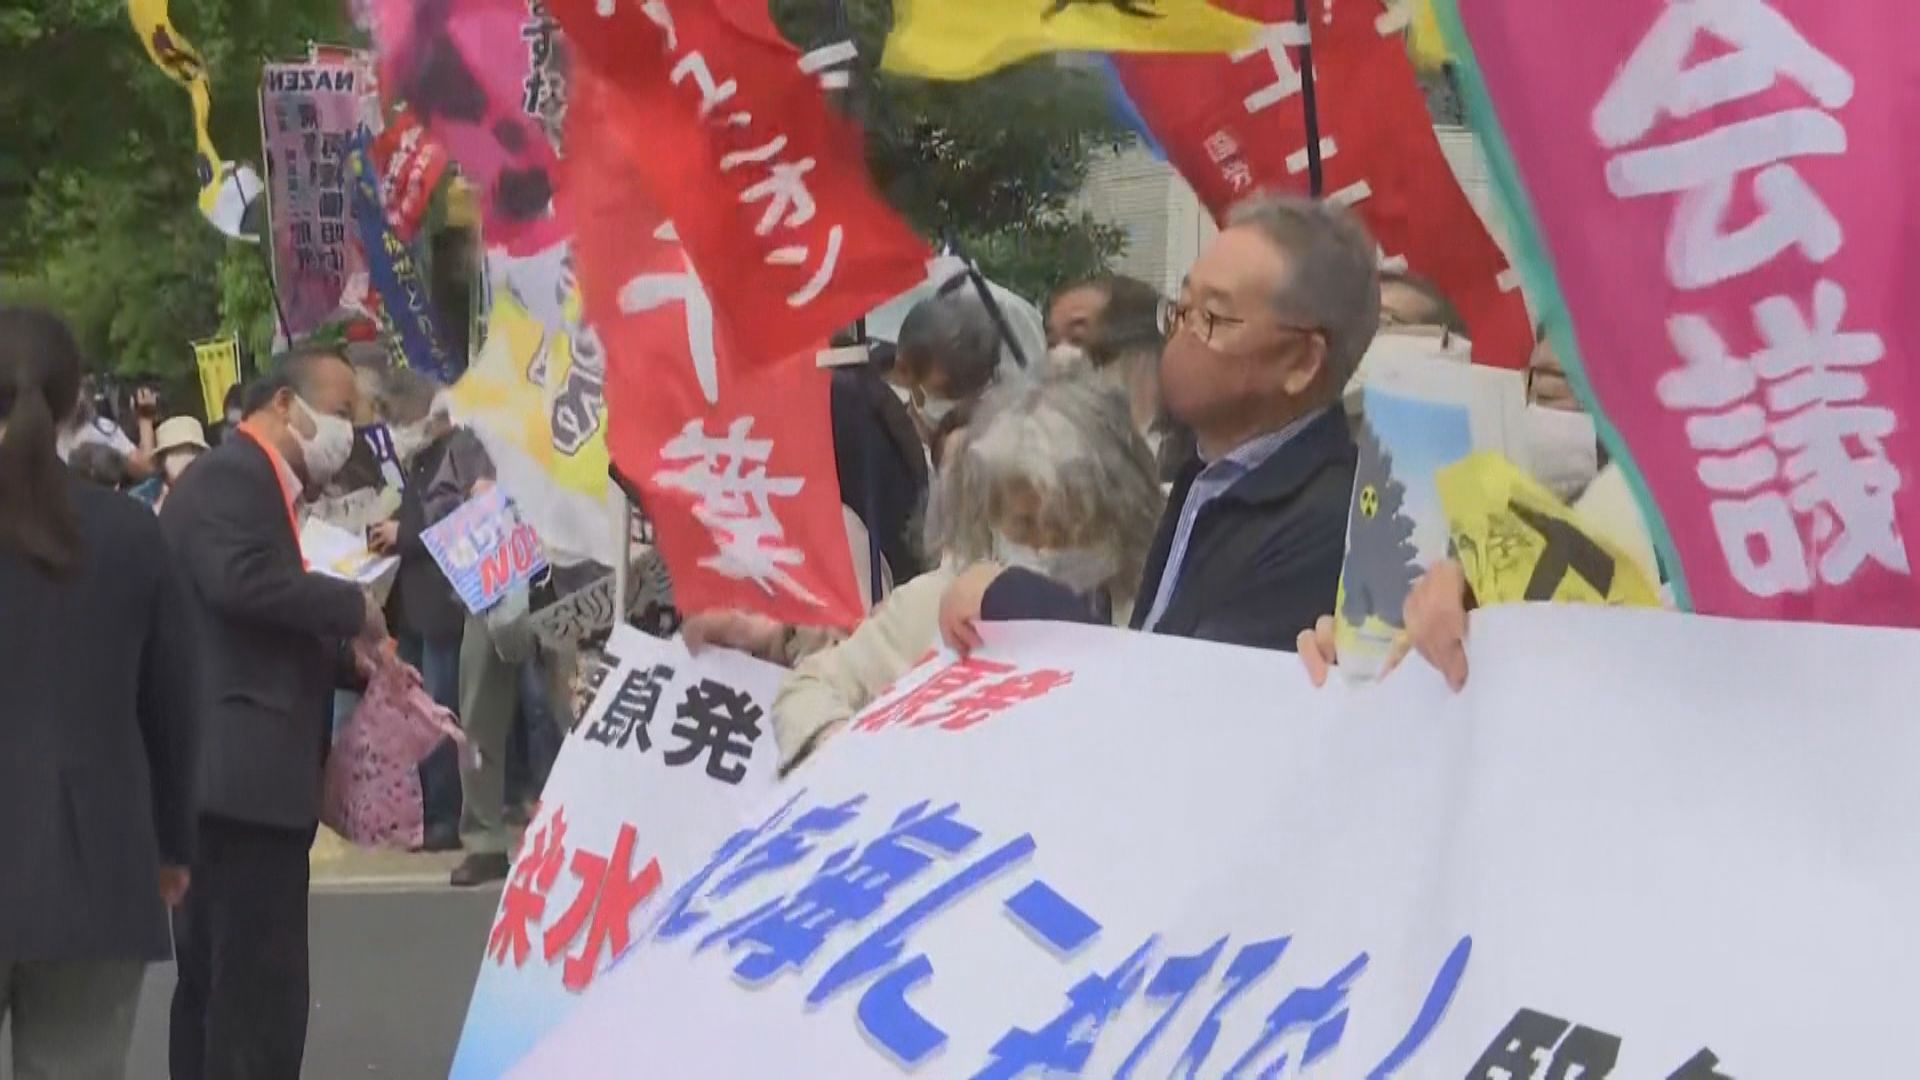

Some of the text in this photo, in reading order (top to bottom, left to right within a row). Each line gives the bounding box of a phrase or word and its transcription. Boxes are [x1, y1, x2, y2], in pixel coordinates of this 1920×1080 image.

[644, 0, 843, 308] ユニオン
[1592, 0, 1910, 597] 会議
[851, 649, 1073, 731] 原発
